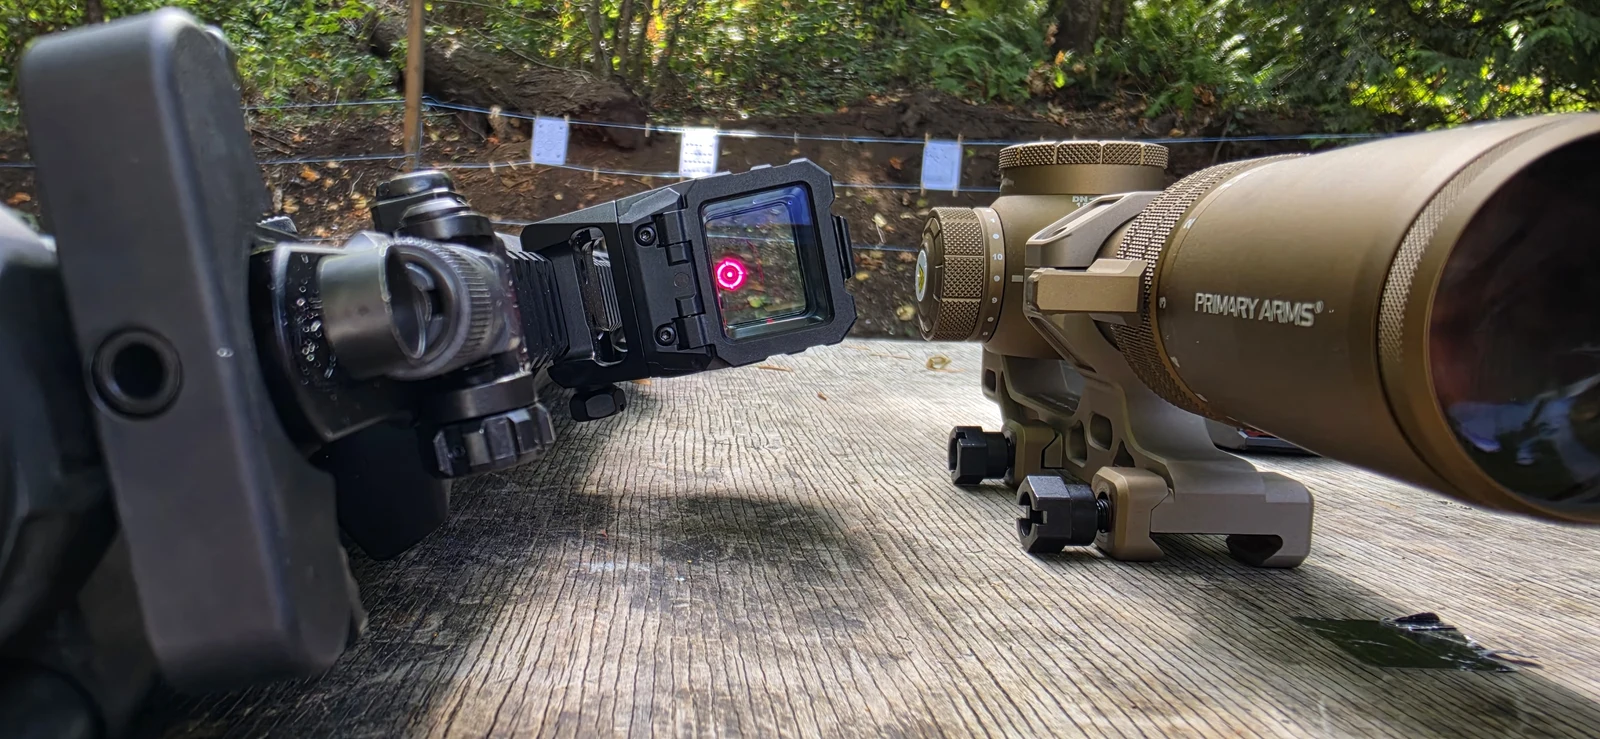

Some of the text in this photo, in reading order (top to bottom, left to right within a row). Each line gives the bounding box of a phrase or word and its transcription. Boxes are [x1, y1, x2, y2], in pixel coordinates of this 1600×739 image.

[1072, 195, 1088, 203] DN
[992, 253, 1003, 261] 10
[1194, 292, 1259, 319] PRIMARY
